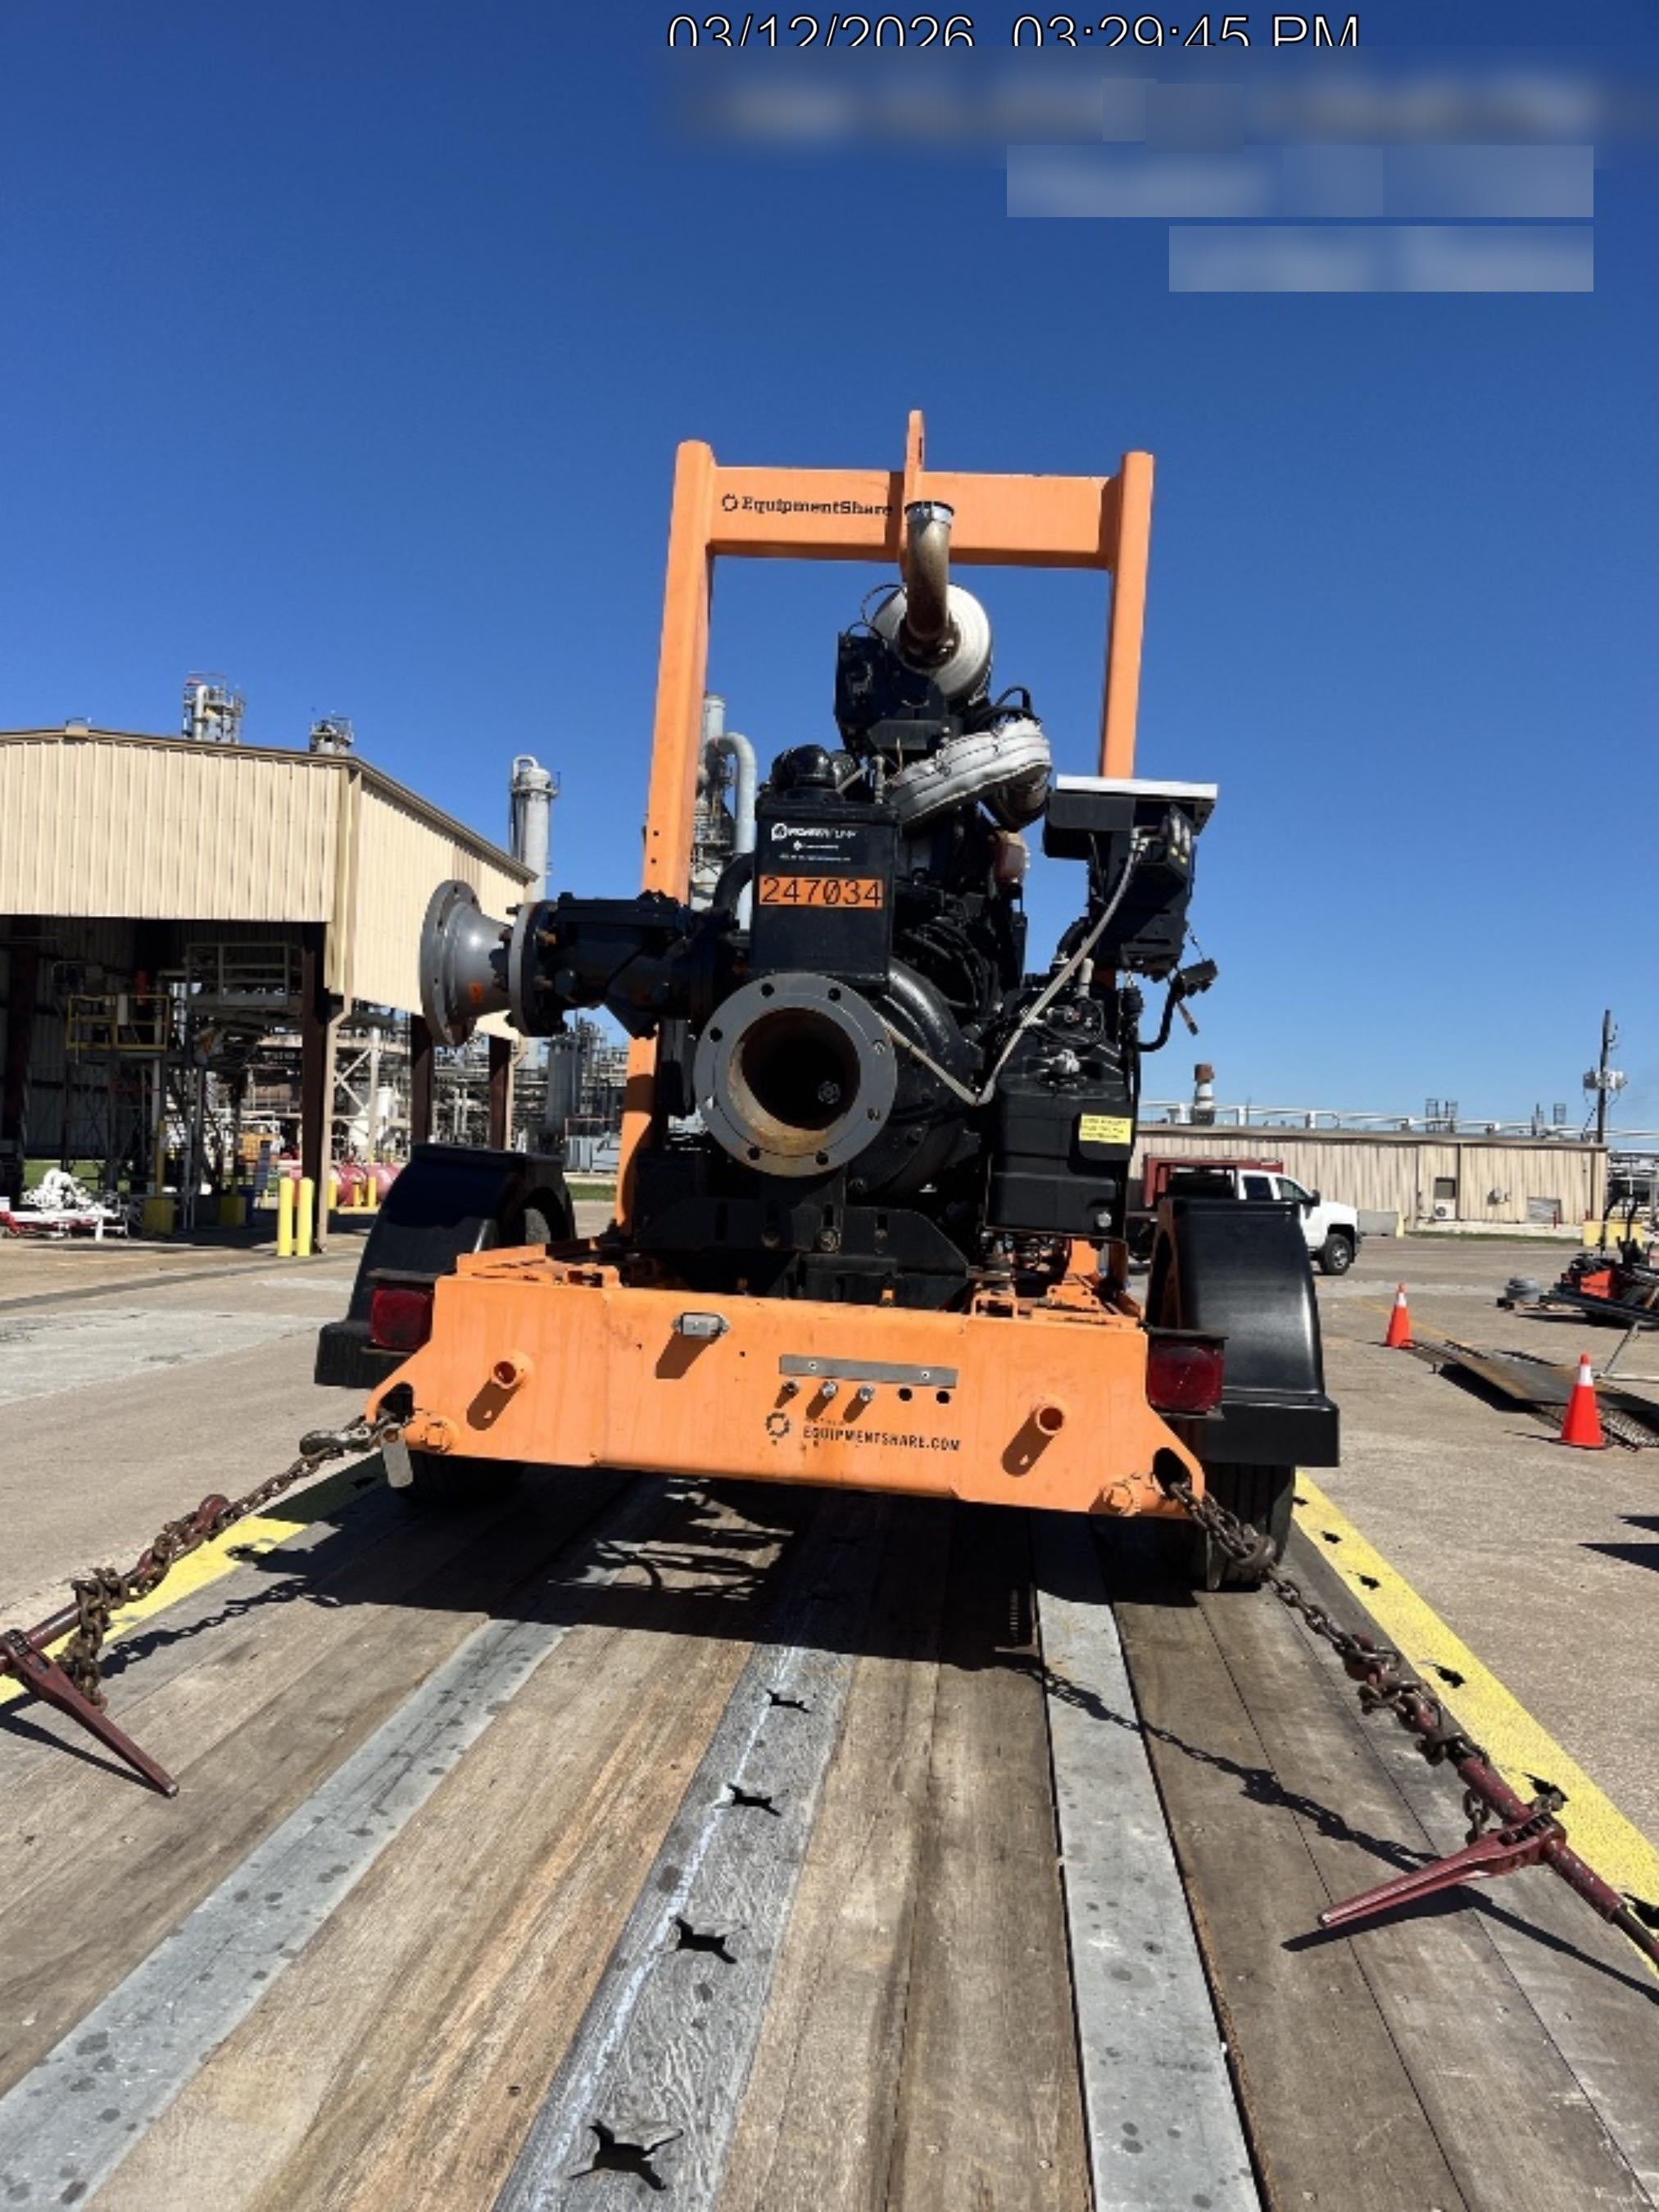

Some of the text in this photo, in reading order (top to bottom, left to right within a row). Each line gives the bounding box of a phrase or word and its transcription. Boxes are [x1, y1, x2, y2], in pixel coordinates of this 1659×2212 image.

[741, 496, 893, 514] EquipmentShare
[762, 877, 881, 906] 247034
[803, 1426, 961, 1451] EQUIPMENTSHARE.COM
